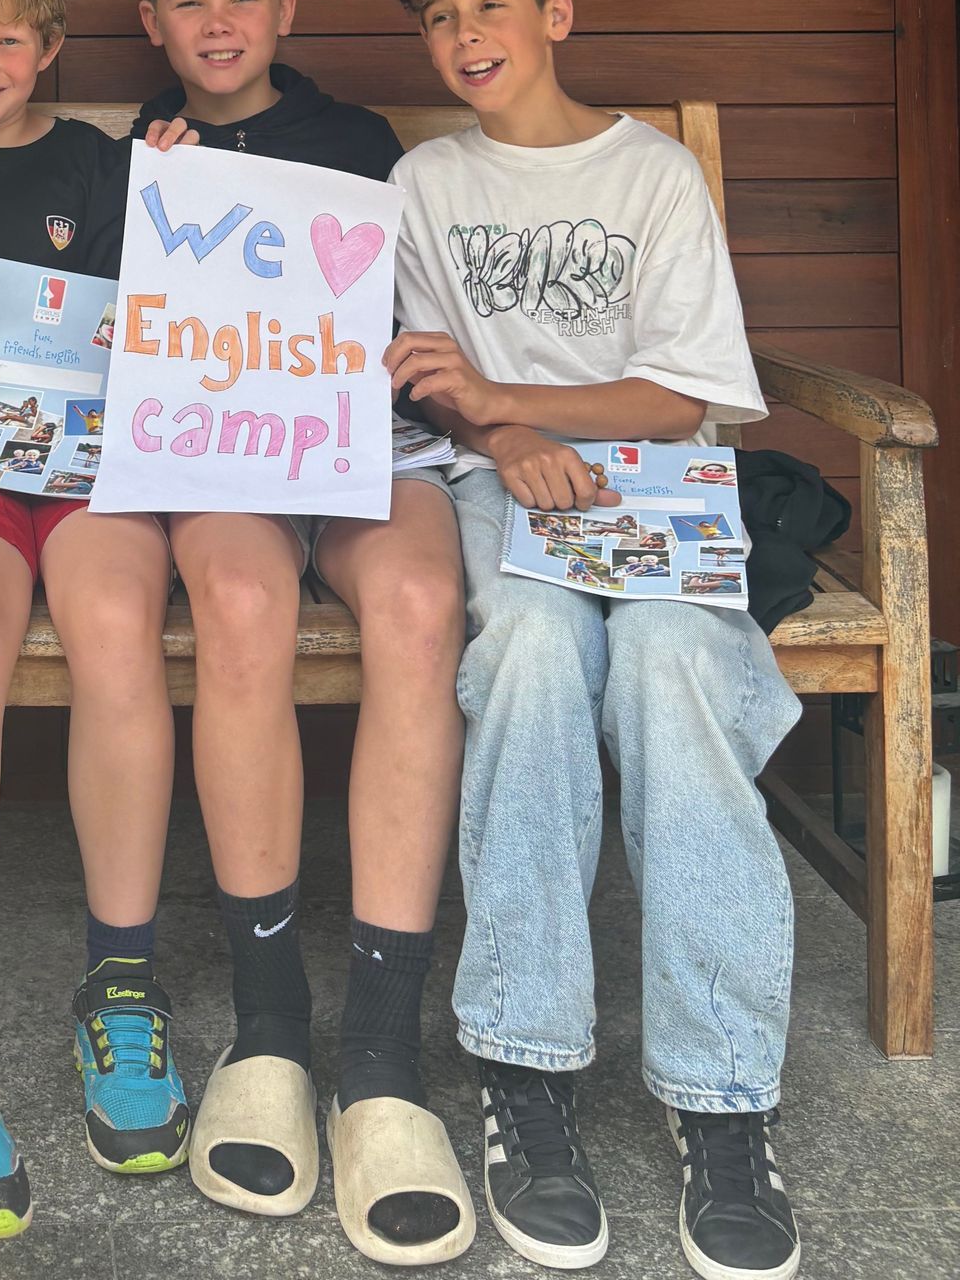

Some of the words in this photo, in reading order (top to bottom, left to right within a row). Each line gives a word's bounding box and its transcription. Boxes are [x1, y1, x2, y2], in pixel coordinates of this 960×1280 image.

[140, 181, 285, 278] We
[124, 293, 366, 392] English
[528, 308, 575, 323] REST
[558, 317, 615, 336] RUSH
[132, 392, 350, 480] camp!
